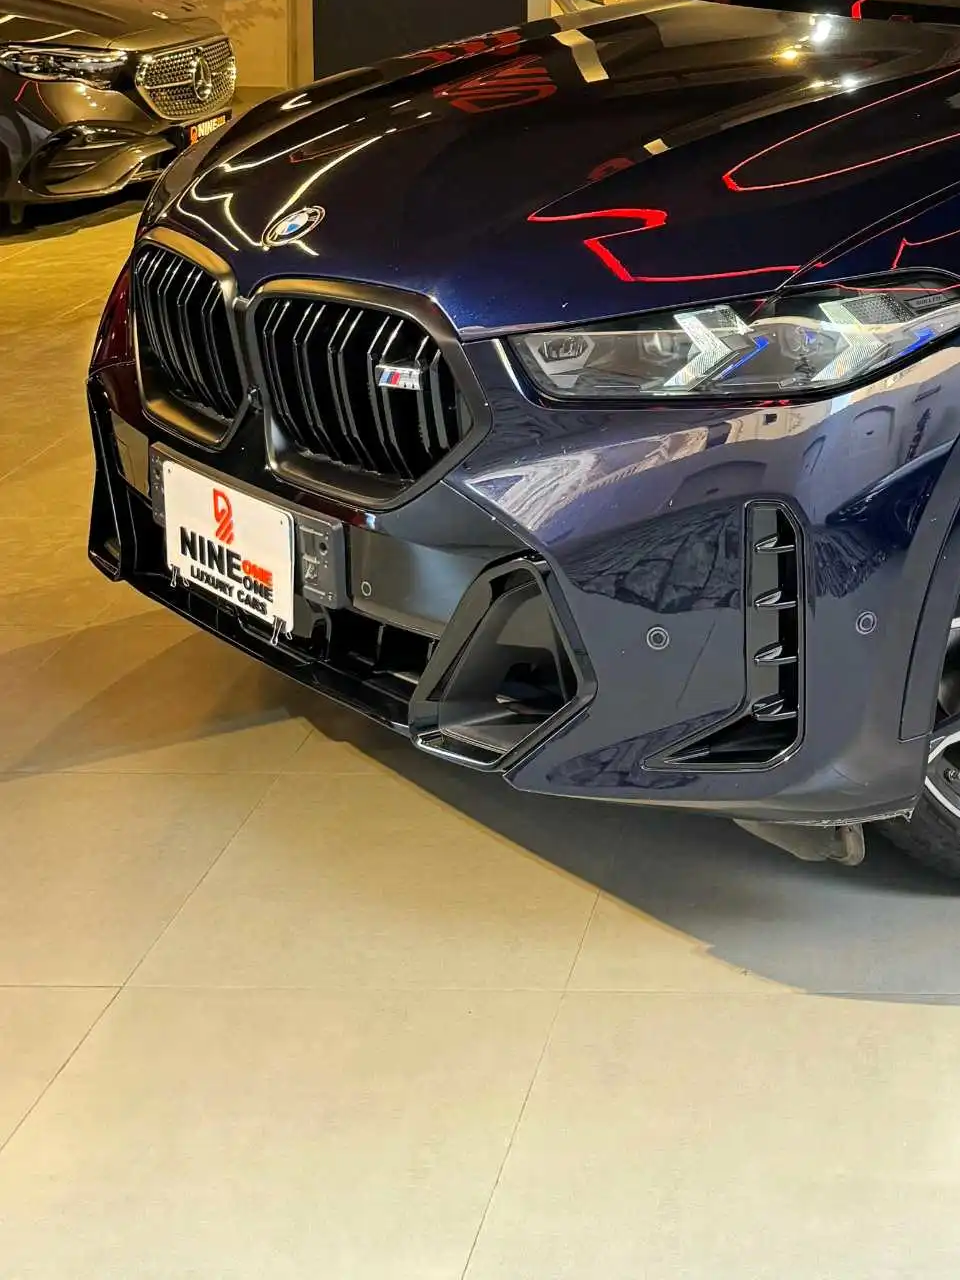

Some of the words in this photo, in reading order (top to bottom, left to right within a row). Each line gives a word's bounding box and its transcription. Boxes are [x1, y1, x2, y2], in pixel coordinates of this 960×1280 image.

[180, 526, 242, 583] NINE
[242, 560, 273, 587] ONE
[191, 565, 234, 597] LUXURY
[237, 589, 268, 615] CARS
[243, 576, 273, 604] ONE
